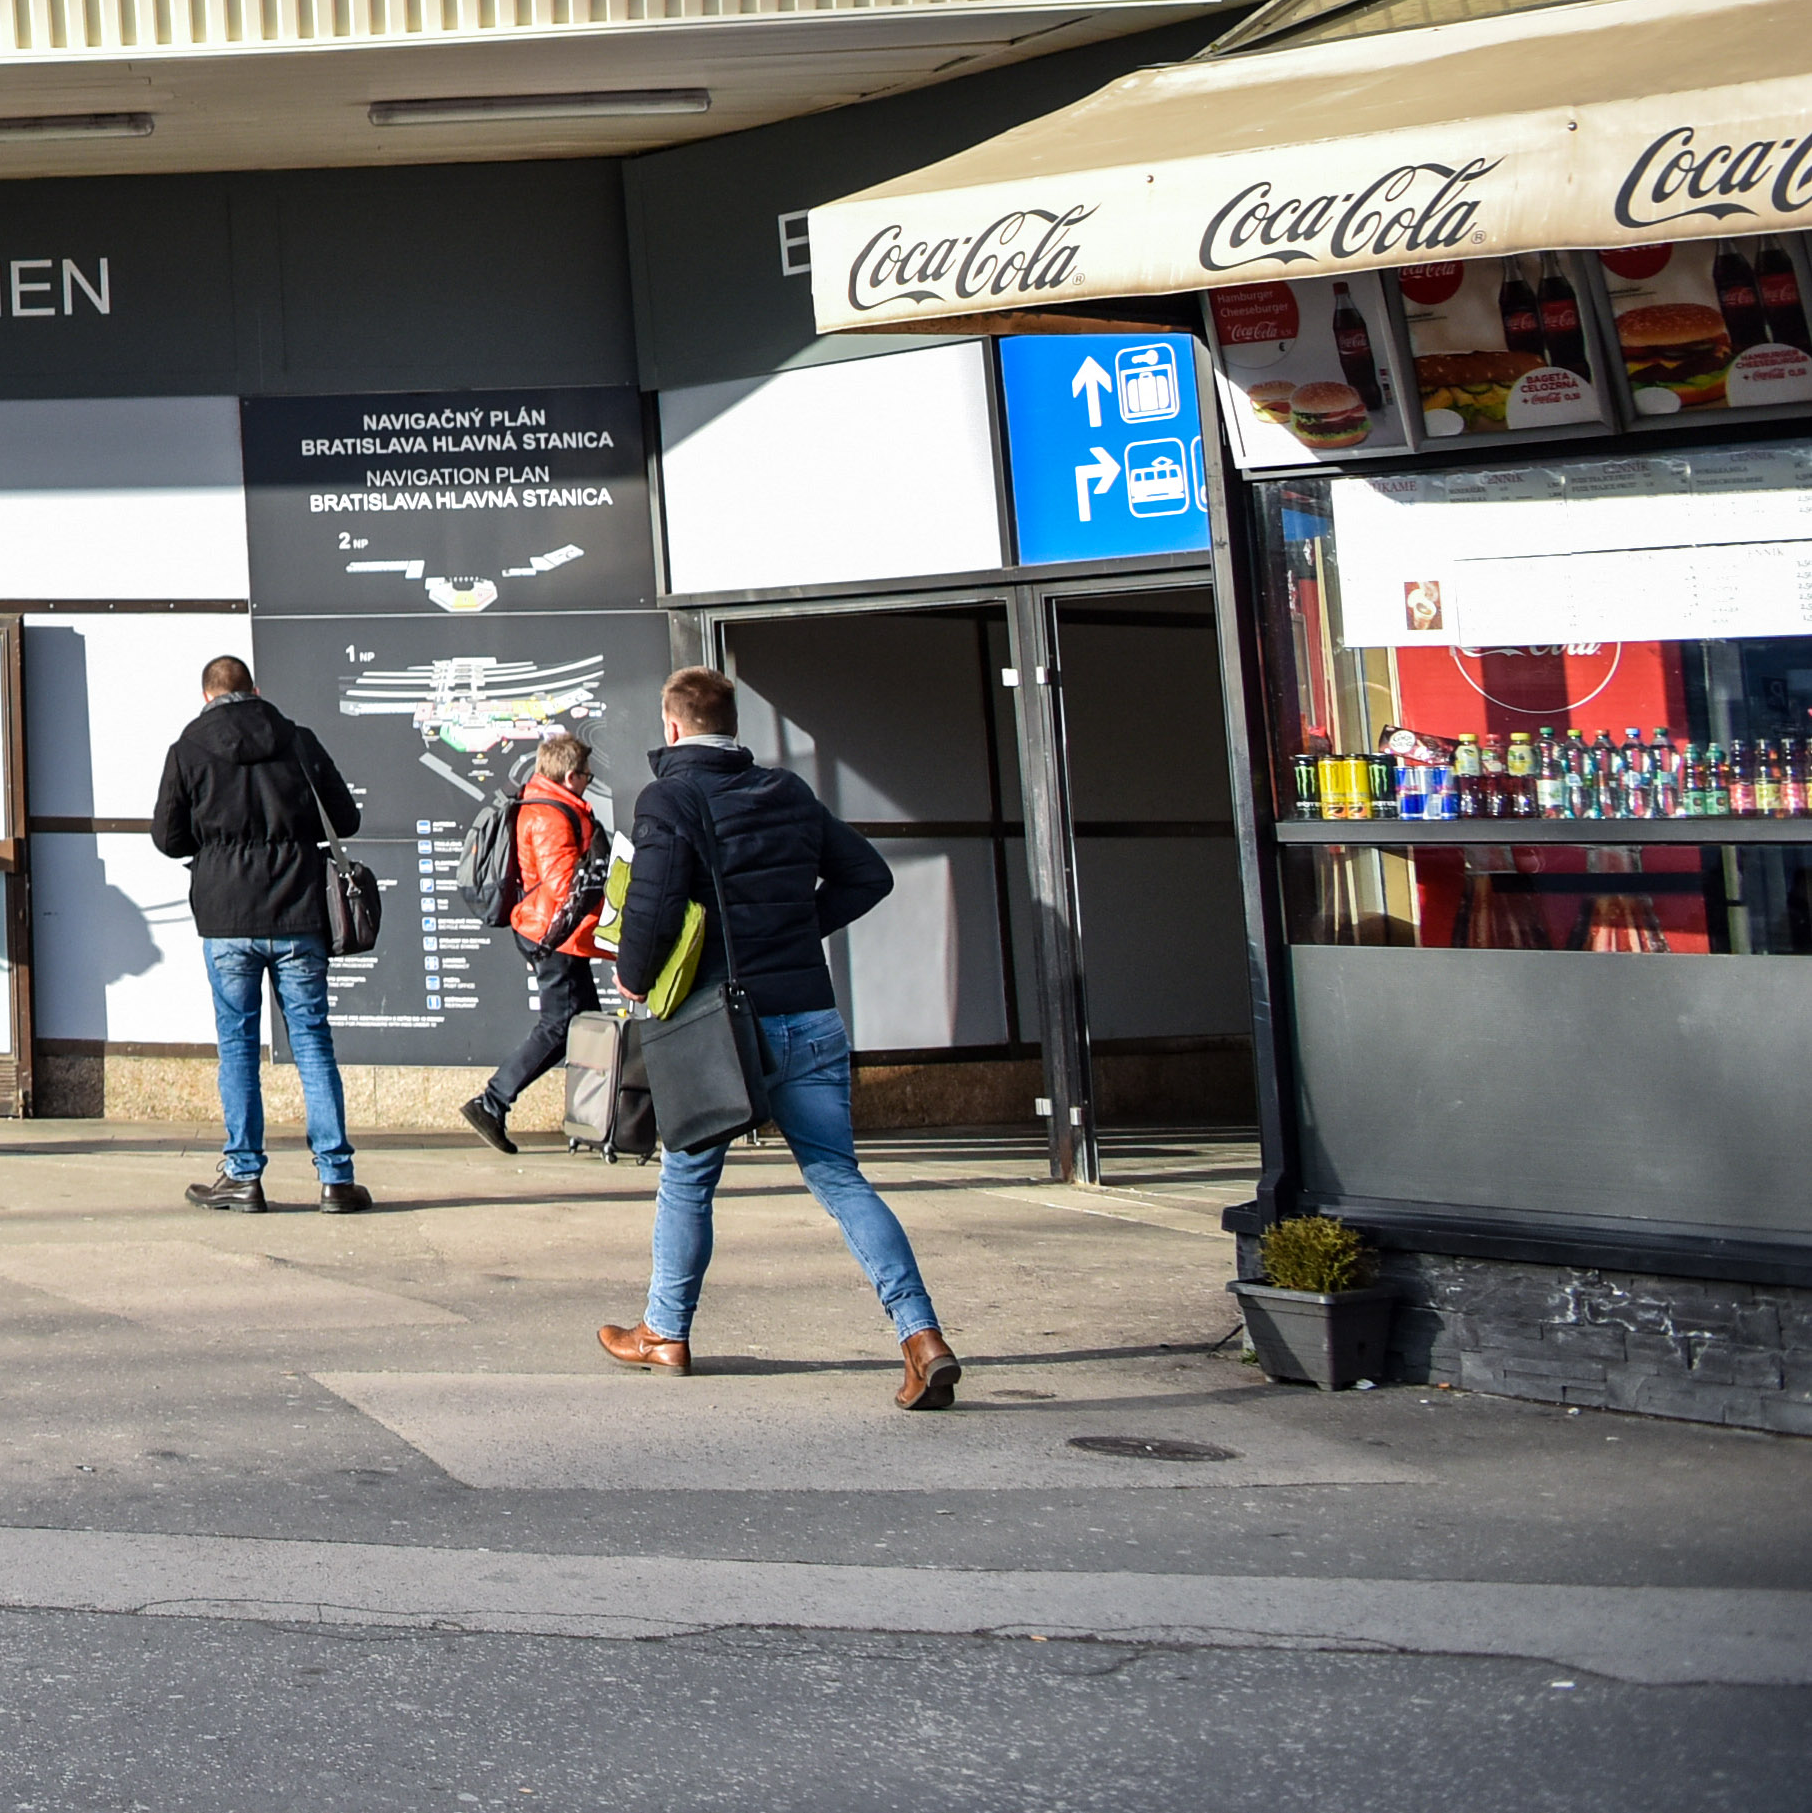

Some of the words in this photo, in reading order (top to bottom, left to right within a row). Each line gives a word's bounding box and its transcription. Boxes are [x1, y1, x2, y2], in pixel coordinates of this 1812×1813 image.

[1613, 126, 1812, 229] Coca-C
[1199, 155, 1509, 273] Coca-Cola
[849, 203, 1102, 311] Coca-Cola
[1217, 289, 1274, 304] Hamburger
[1220, 302, 1289, 318] Cheeseburger
[1526, 372, 1570, 384] BAGETA
[363, 408, 483, 431] NAVIGAČNÝ
[490, 406, 546, 427] PLÁN
[301, 437, 428, 456] BRATISLAVA
[433, 430, 517, 453] HLAVNÁ
[523, 431, 614, 450] STANICA
[366, 467, 489, 487] NAVIGATION
[496, 466, 549, 483] PLAN
[310, 492, 432, 512] BRATISLAVA
[436, 487, 518, 509] HLAVNÁ
[523, 488, 613, 507] STANICA
[338, 532, 351, 550] 2
[353, 538, 369, 549] NP
[345, 644, 356, 662] 1
[359, 652, 375, 663] NP
